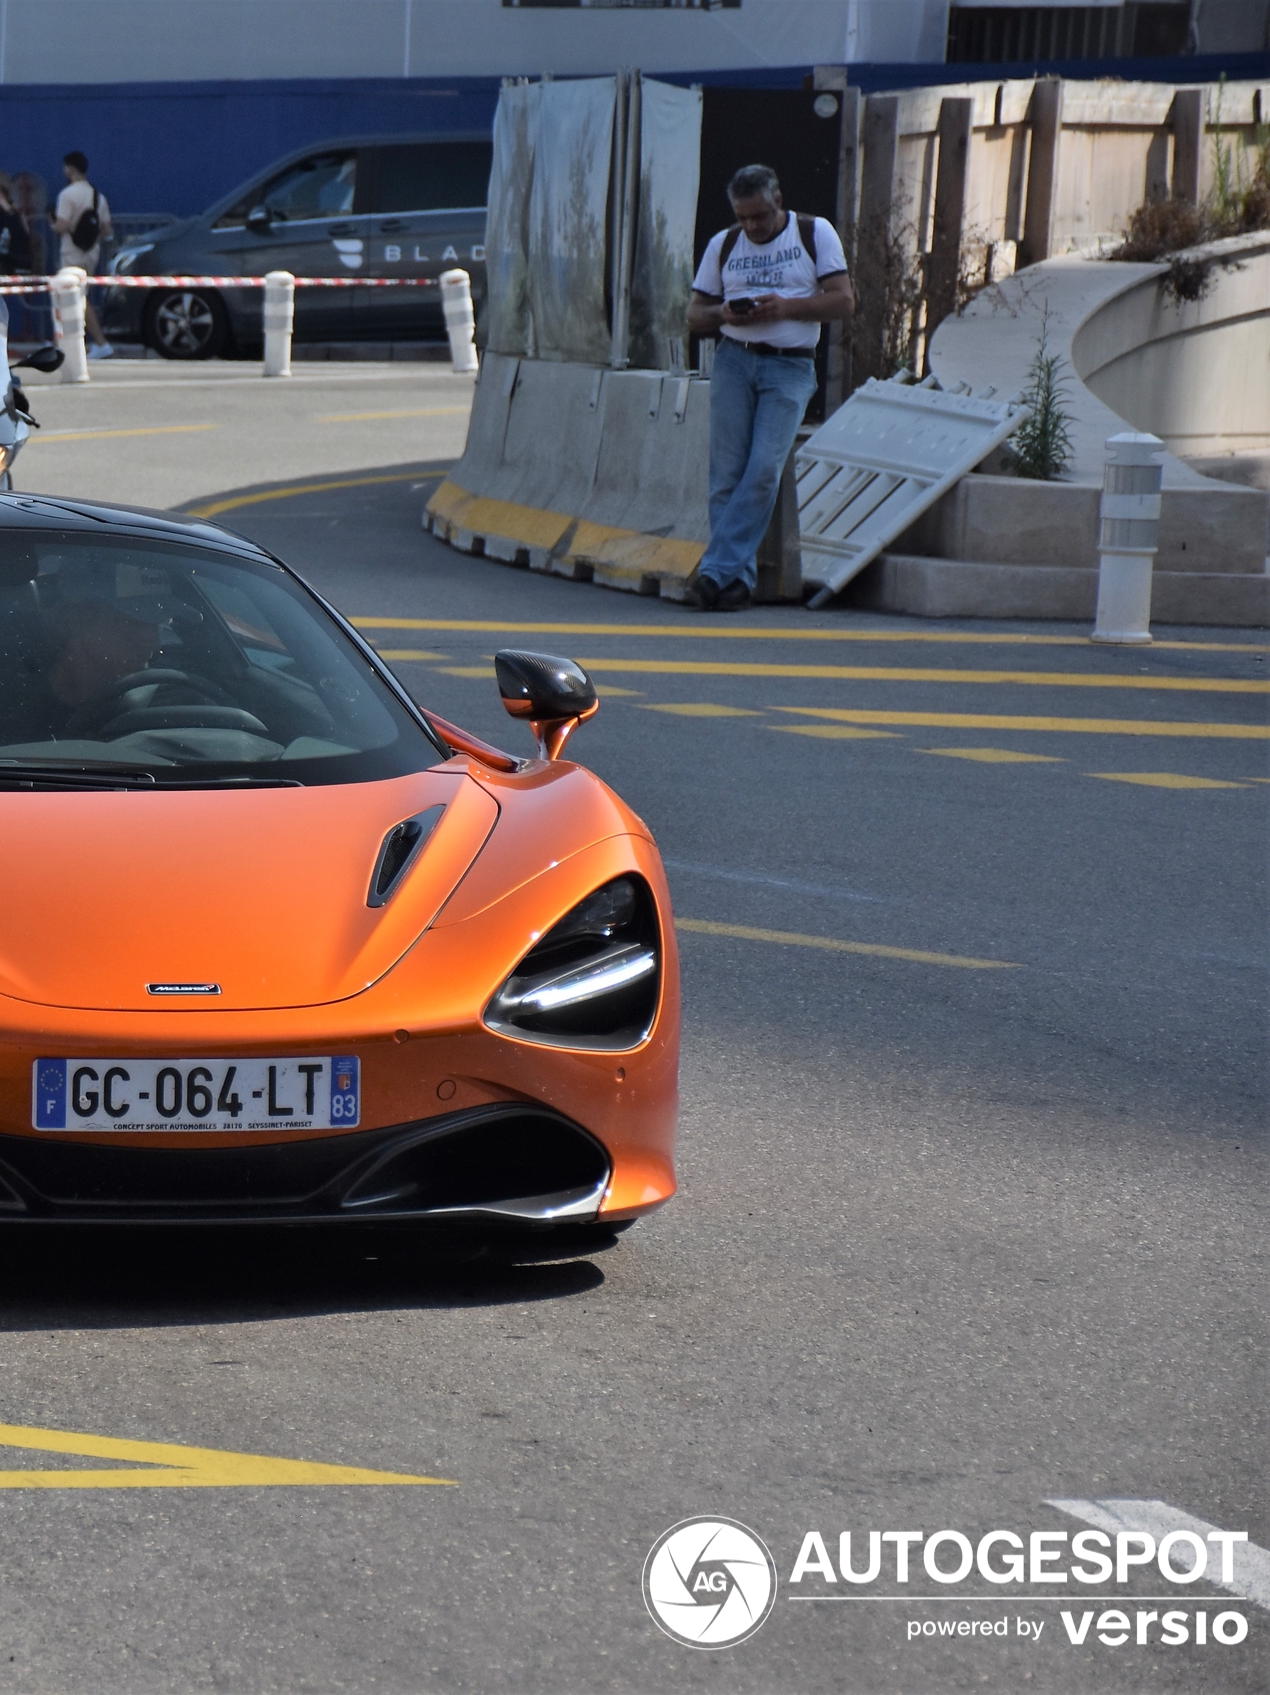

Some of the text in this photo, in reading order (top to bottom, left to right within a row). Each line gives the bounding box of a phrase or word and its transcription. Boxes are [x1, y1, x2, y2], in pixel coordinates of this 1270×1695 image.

[727, 246, 802, 271] GREENLAND
[71, 1064, 323, 1118] GC-064-LT
[46, 1100, 56, 1114] F
[332, 1094, 356, 1118] 83
[247, 1121, 313, 1129] SEYSSINET-PARISET
